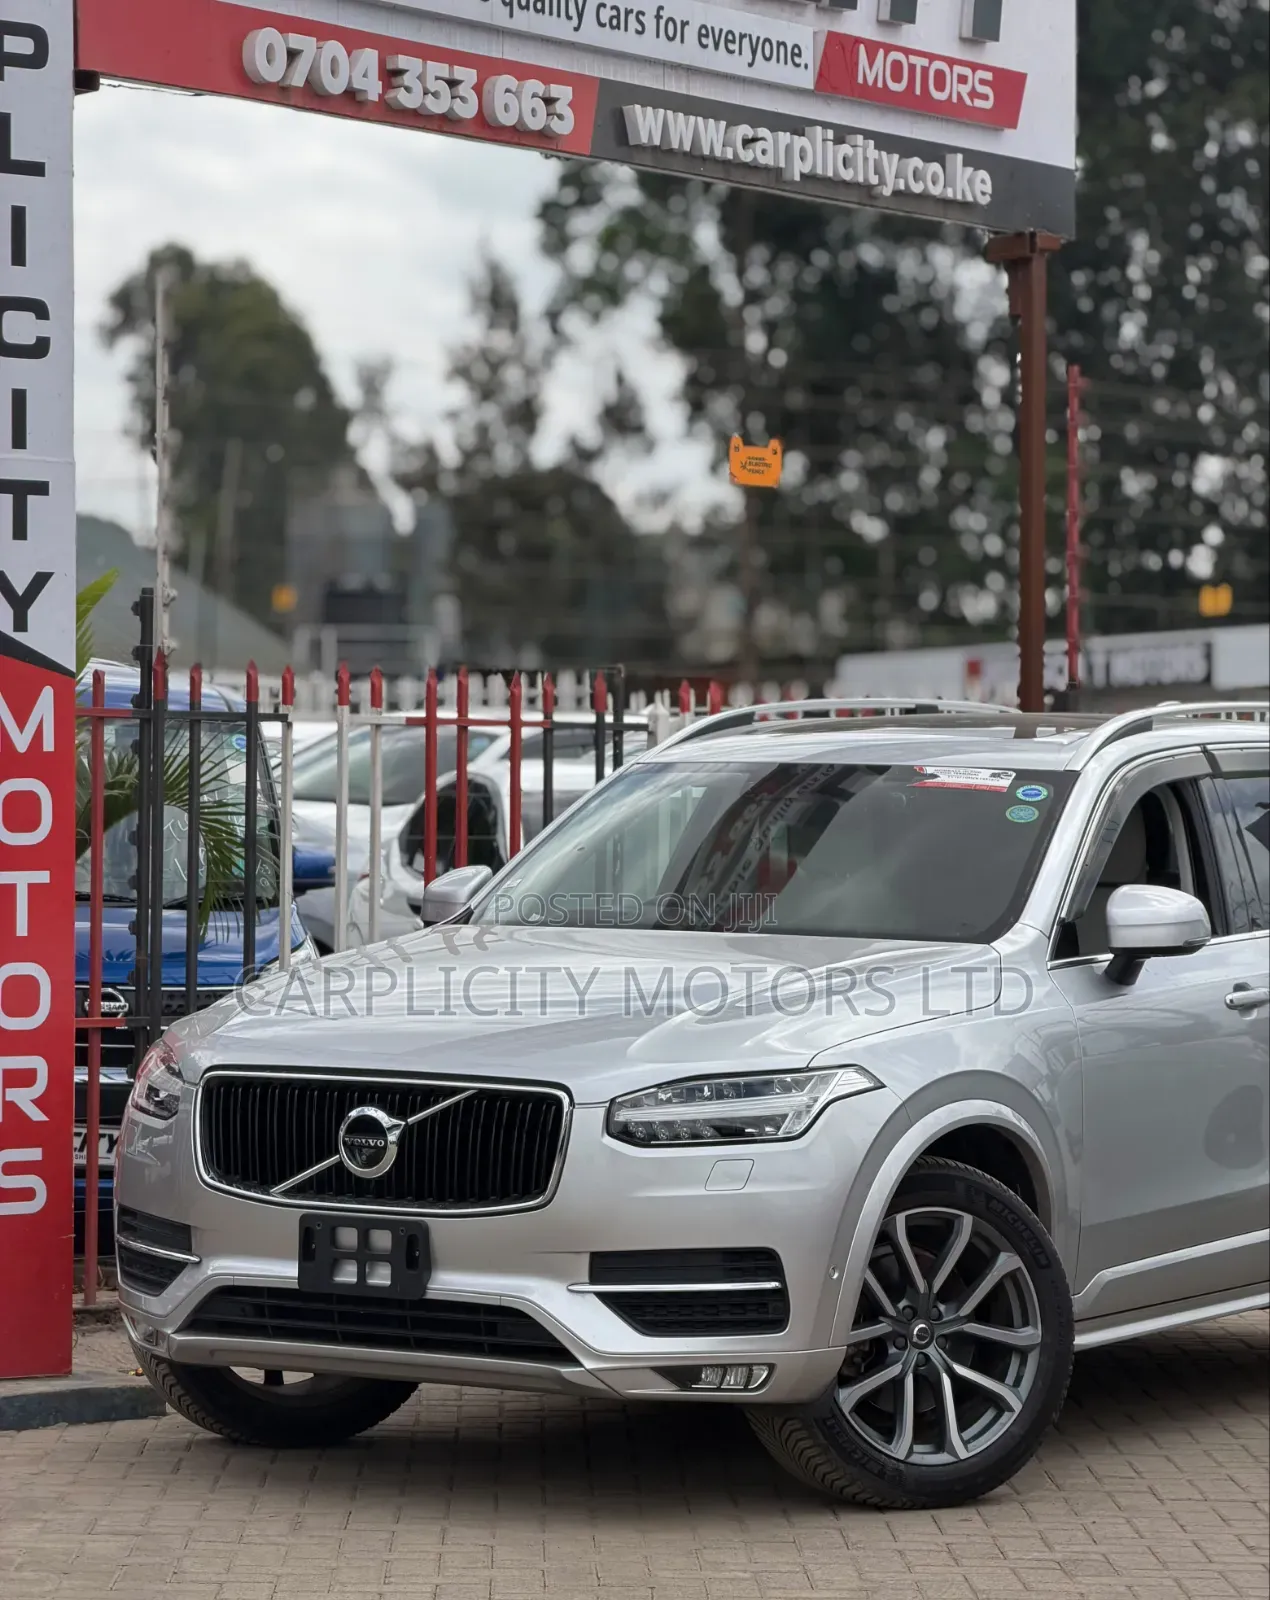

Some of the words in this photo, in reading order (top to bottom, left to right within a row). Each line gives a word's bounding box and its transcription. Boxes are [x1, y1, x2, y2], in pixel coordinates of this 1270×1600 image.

[595, 2, 646, 35] cars
[654, 5, 690, 44] for
[697, 23, 809, 70] everyone.
[857, 44, 995, 110] MOTORS
[242, 26, 383, 102] 0704
[385, 54, 479, 120] 353
[483, 74, 575, 137] 663
[621, 103, 993, 206] www.carplicity.co.ke
[0, 685, 55, 1215] MOTORS
[344, 1137, 385, 1147] VOLVO
